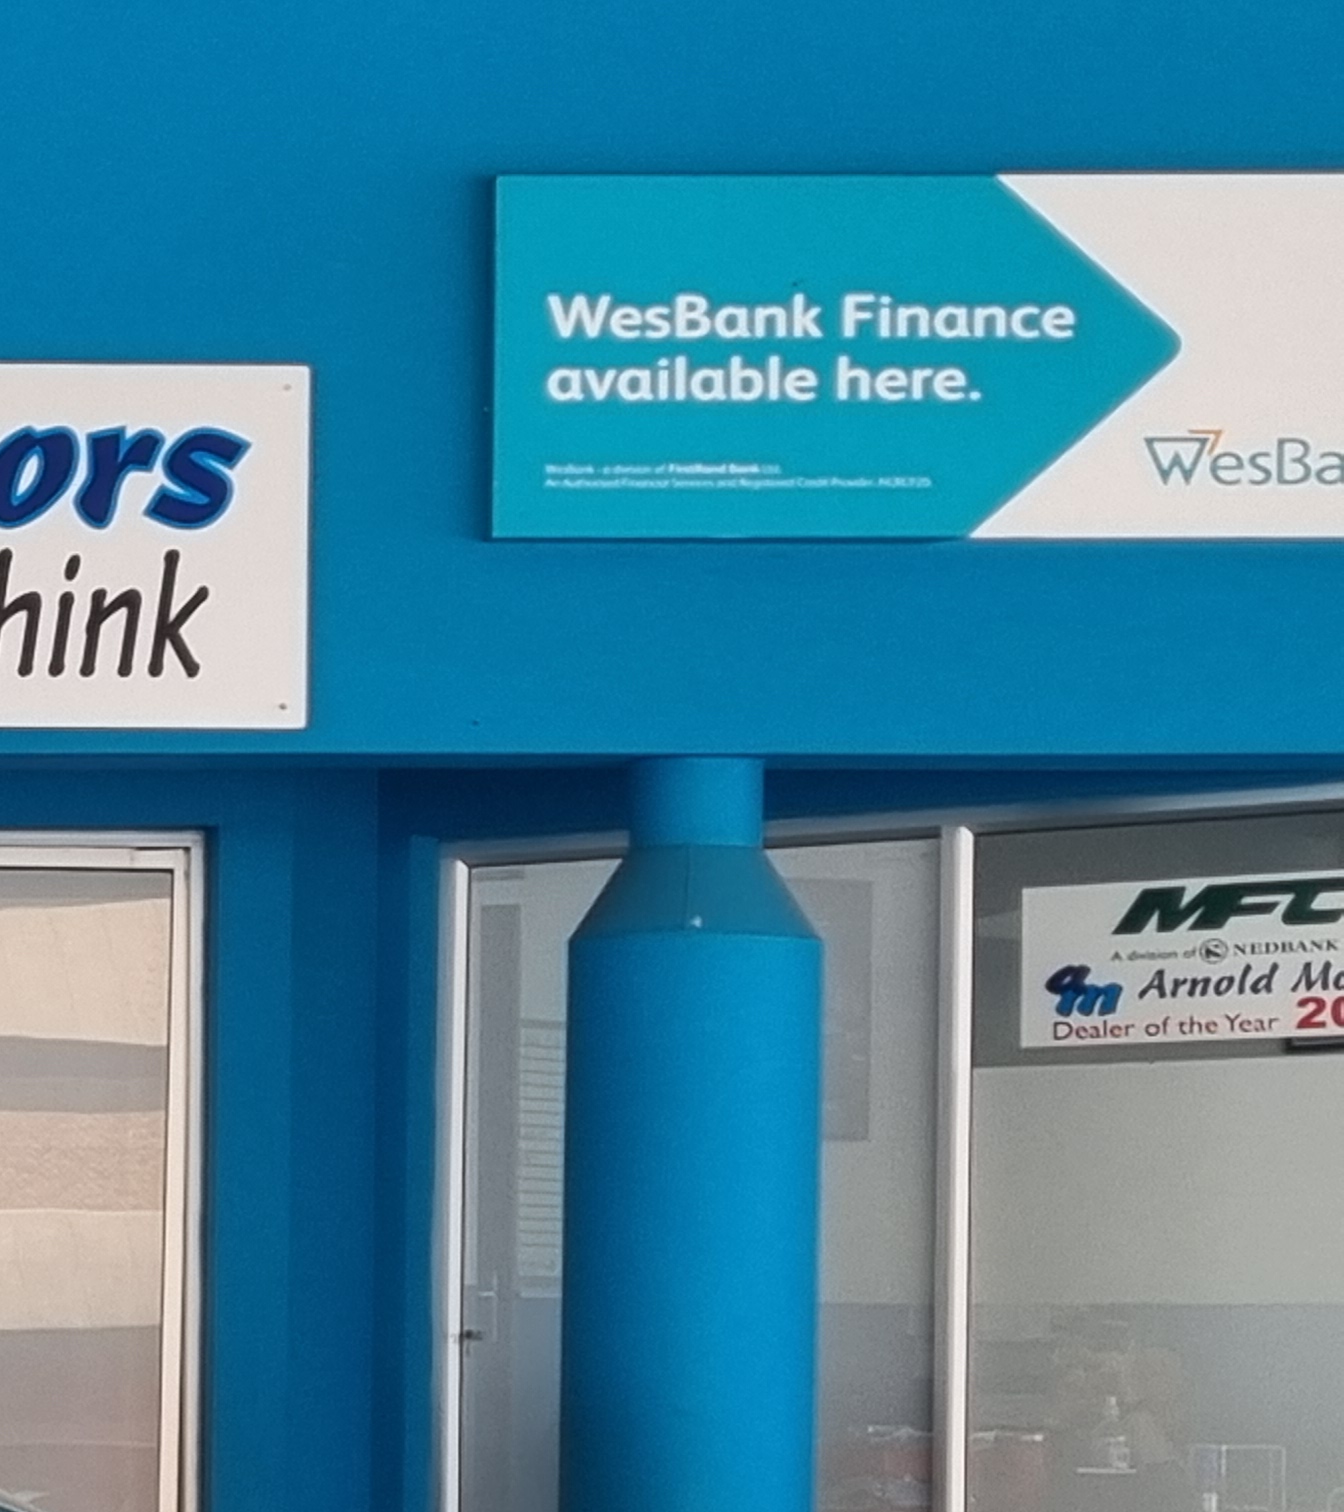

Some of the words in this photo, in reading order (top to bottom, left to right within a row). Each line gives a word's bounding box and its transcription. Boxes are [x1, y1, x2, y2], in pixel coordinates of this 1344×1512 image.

[548, 292, 823, 340] WesBank
[842, 291, 1076, 340] Finance
[547, 355, 820, 401] available
[837, 355, 983, 401] here.
[1127, 949, 1179, 962] division
[1182, 946, 1198, 960] of
[1233, 938, 1339, 957] NEDBANK
[1137, 961, 1280, 1001] Arnold
[1053, 1019, 1135, 1041] Dealer
[1145, 1016, 1169, 1037] of
[1179, 1014, 1219, 1035] the
[1224, 1013, 1281, 1034] Year
